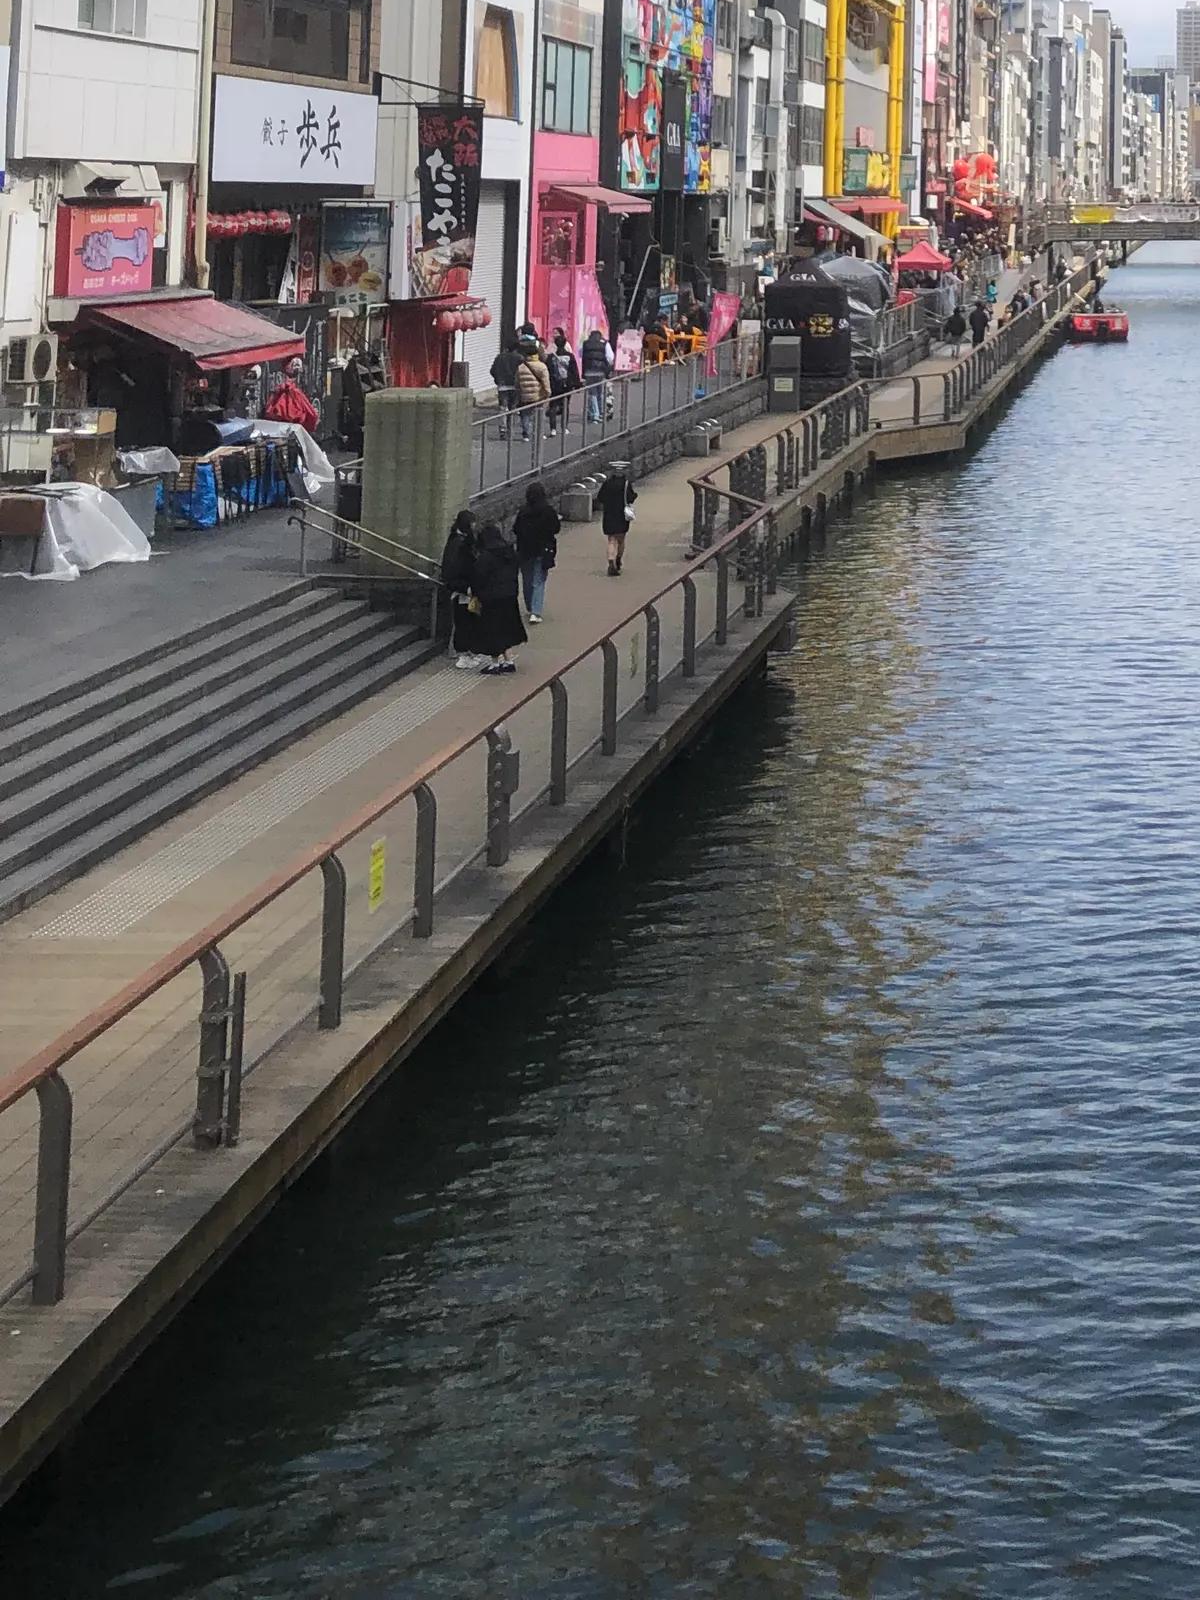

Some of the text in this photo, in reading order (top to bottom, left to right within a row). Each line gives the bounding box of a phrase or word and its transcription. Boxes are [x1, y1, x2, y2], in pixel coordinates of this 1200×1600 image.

[260, 99, 342, 169] 餃子 歩兵
[426, 148, 458, 265] たこやき
